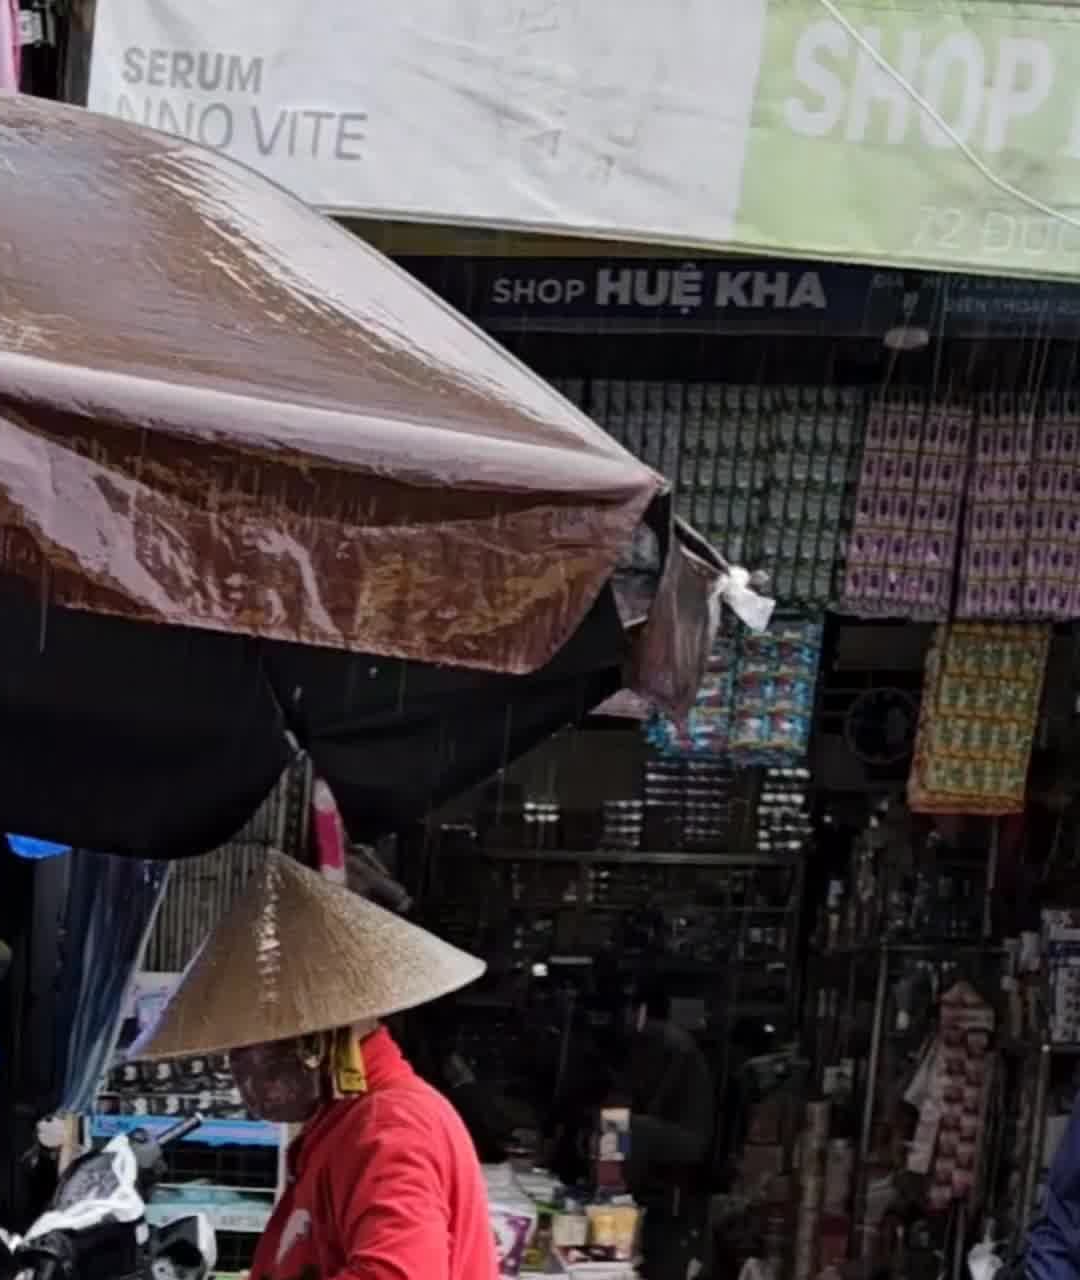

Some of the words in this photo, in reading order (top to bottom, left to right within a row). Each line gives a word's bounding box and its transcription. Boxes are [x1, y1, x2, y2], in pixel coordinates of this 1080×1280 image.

[122, 46, 264, 94] SERUM
[782, 19, 1056, 152] SHOP
[250, 106, 369, 160] VITE
[492, 278, 586, 305] SHOP
[595, 264, 703, 315] HUỆ
[715, 270, 826, 309] KHA
